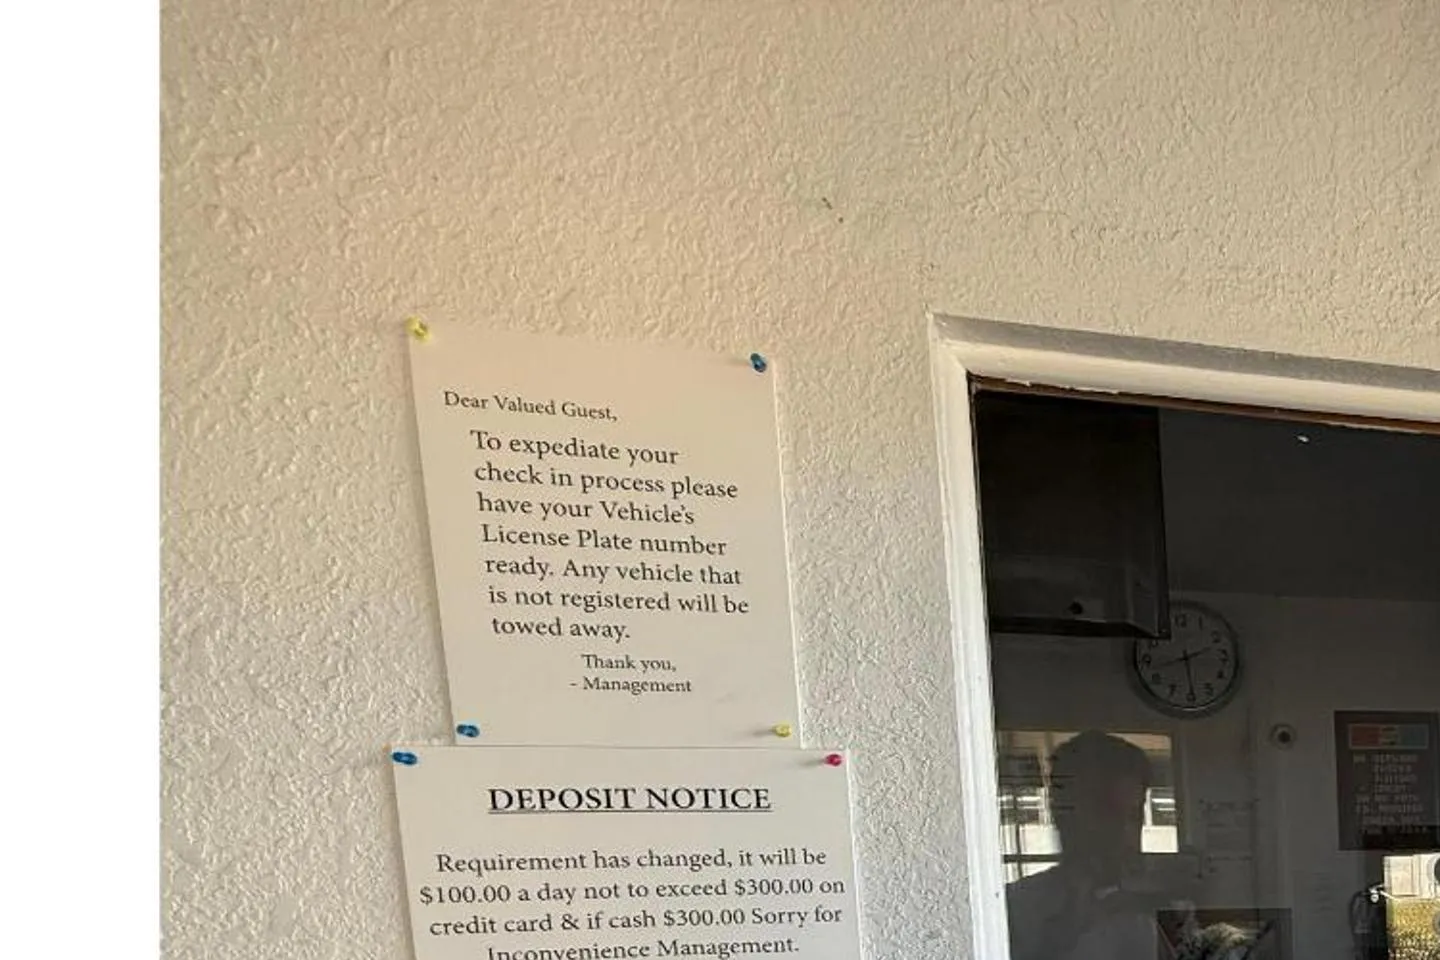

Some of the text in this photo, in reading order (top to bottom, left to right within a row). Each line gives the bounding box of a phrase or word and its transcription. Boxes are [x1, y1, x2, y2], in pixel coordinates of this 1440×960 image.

[444, 391, 617, 421] Dear Valued Guest,
[470, 430, 679, 468] To expediate your
[474, 461, 738, 500] check in process please
[476, 491, 694, 524] have your Vehicle's
[481, 524, 727, 555] License Plate number
[484, 556, 740, 584] ready. Any vehicle that
[489, 585, 749, 613] is not registered will be
[492, 616, 630, 644] towed away.
[580, 654, 676, 674] Thank you,
[583, 676, 691, 696] Management
[488, 787, 773, 815] DEPOSIT NOTICE
[436, 848, 826, 877] Requirement has changed, it will be
[420, 879, 845, 906] $100.00 a day not to exceed $300.00 on
[430, 904, 842, 935] credit card & if cash $300.00 Sorry for
[657, 939, 799, 960] Management.
